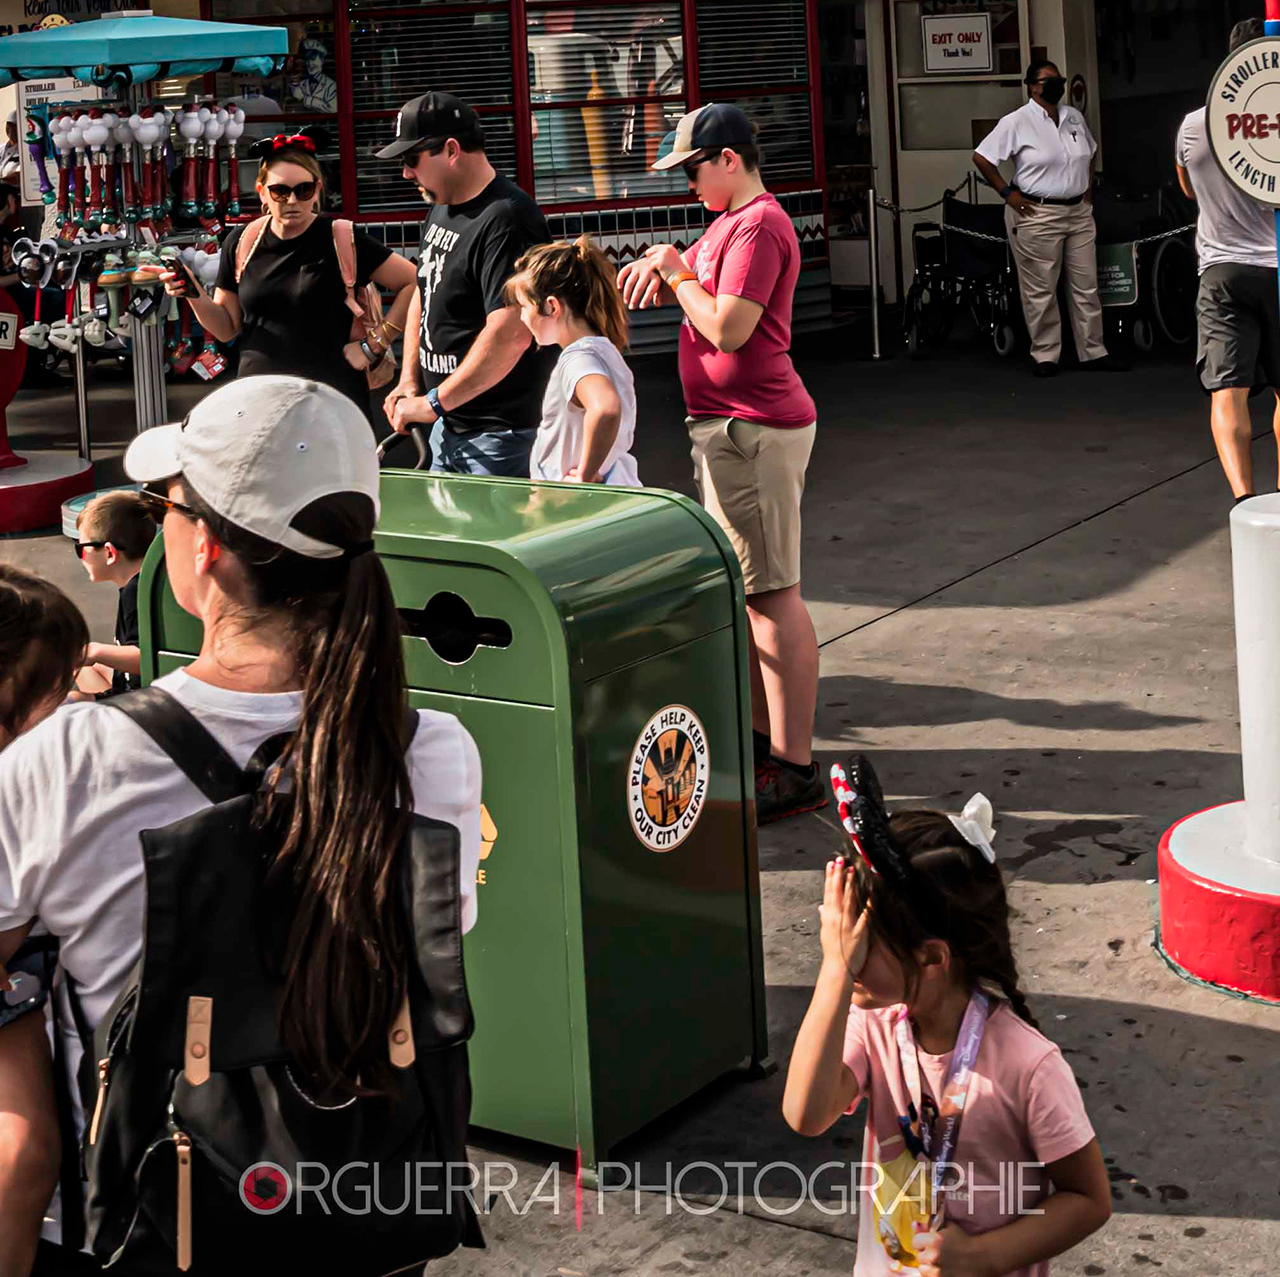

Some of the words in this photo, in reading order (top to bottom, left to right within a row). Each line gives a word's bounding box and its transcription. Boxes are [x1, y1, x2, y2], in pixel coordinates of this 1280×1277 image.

[931, 32, 953, 45] EXIT
[957, 32, 983, 43] ONLY
[1221, 51, 1280, 103] STROLLER
[1228, 150, 1276, 193] LENGTH
[631, 724, 657, 787] PLEASE
[660, 711, 686, 729] HELP
[687, 720, 705, 756] KEEP
[634, 807, 653, 840] OUR
[656, 826, 679, 845] CITY
[682, 779, 705, 830] CLEAN
